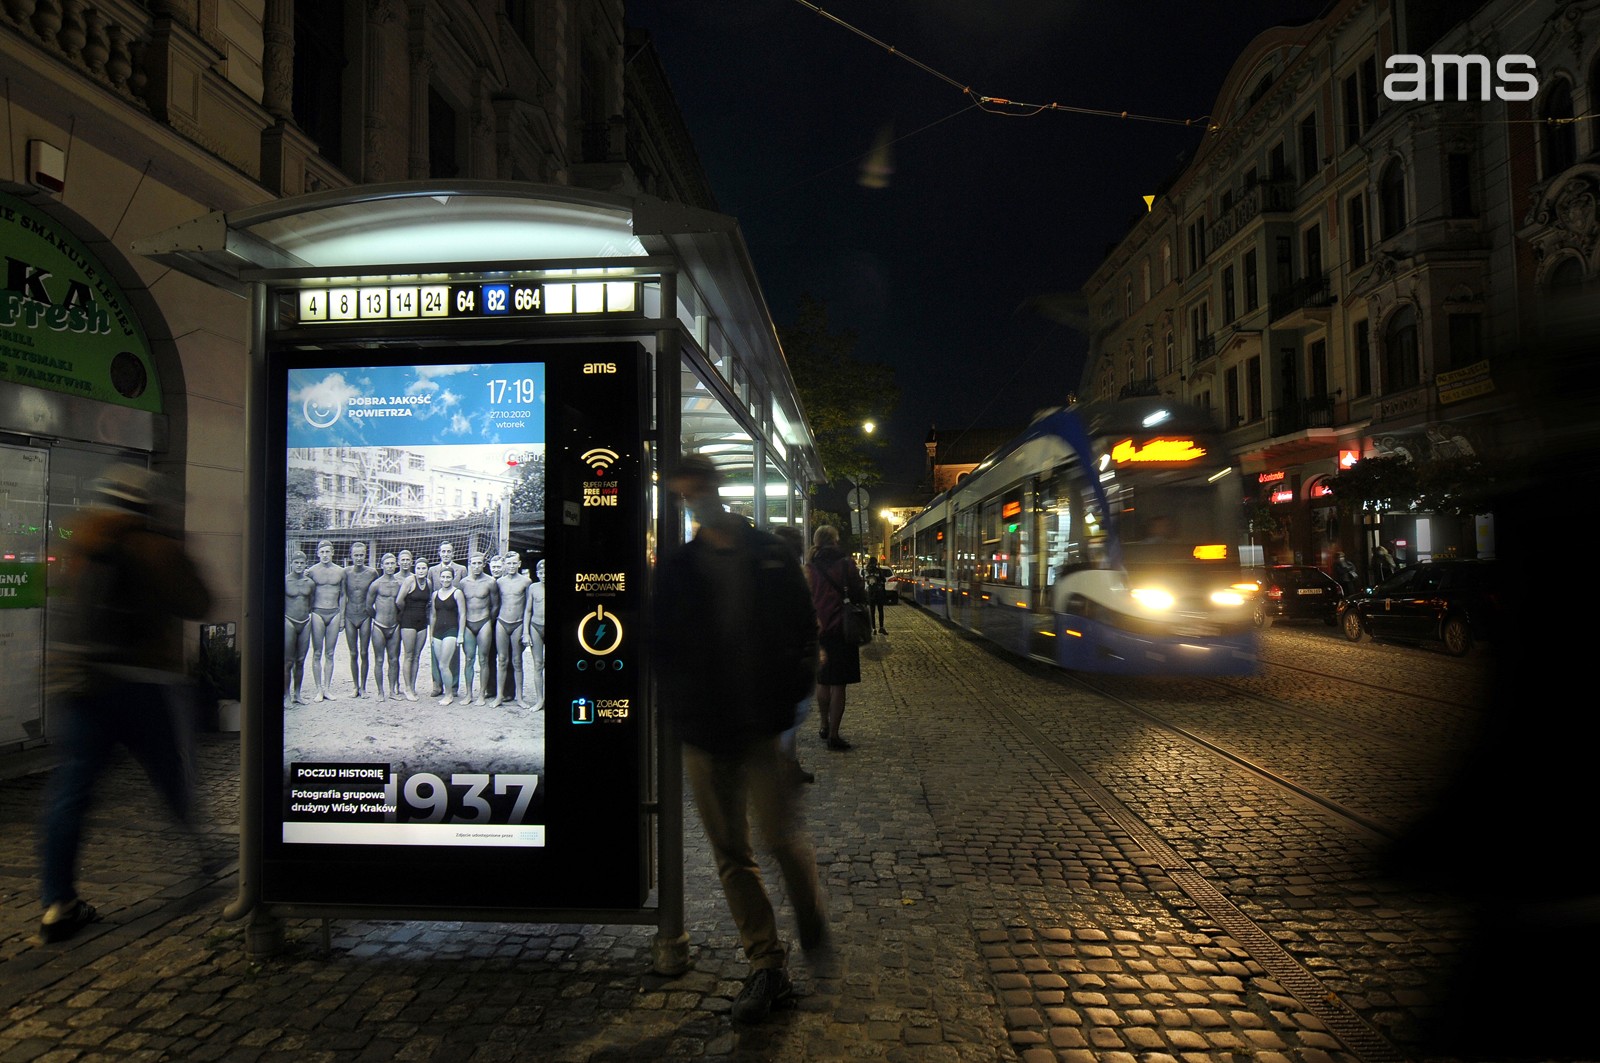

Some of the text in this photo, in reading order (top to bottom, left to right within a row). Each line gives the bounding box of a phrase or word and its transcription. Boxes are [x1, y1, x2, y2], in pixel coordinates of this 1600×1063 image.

[20, 215, 95, 279] SMAKUJE
[95, 280, 134, 337] LEPIEJ
[309, 289, 541, 315] 4 8 13 14 24 64 82 664
[583, 362, 617, 374] ams
[486, 378, 535, 405] 17:19
[348, 394, 432, 406] DOBRA JAKOŚĆ
[348, 408, 412, 417] POWIETRZA
[490, 411, 531, 419] 27.10.2020
[583, 495, 617, 507] ZONE
[576, 573, 625, 582] DARMOWE
[575, 583, 625, 592] ŁADOWANIE
[596, 699, 629, 708] ZOBACZ
[597, 709, 629, 718] WIĘCEJ
[297, 769, 383, 780] POCZUJ HISTORIĘ
[291, 789, 385, 801] Fotografia grupowa
[384, 772, 539, 825] 1937
[291, 802, 396, 813] drużyny Wisły Kraków
